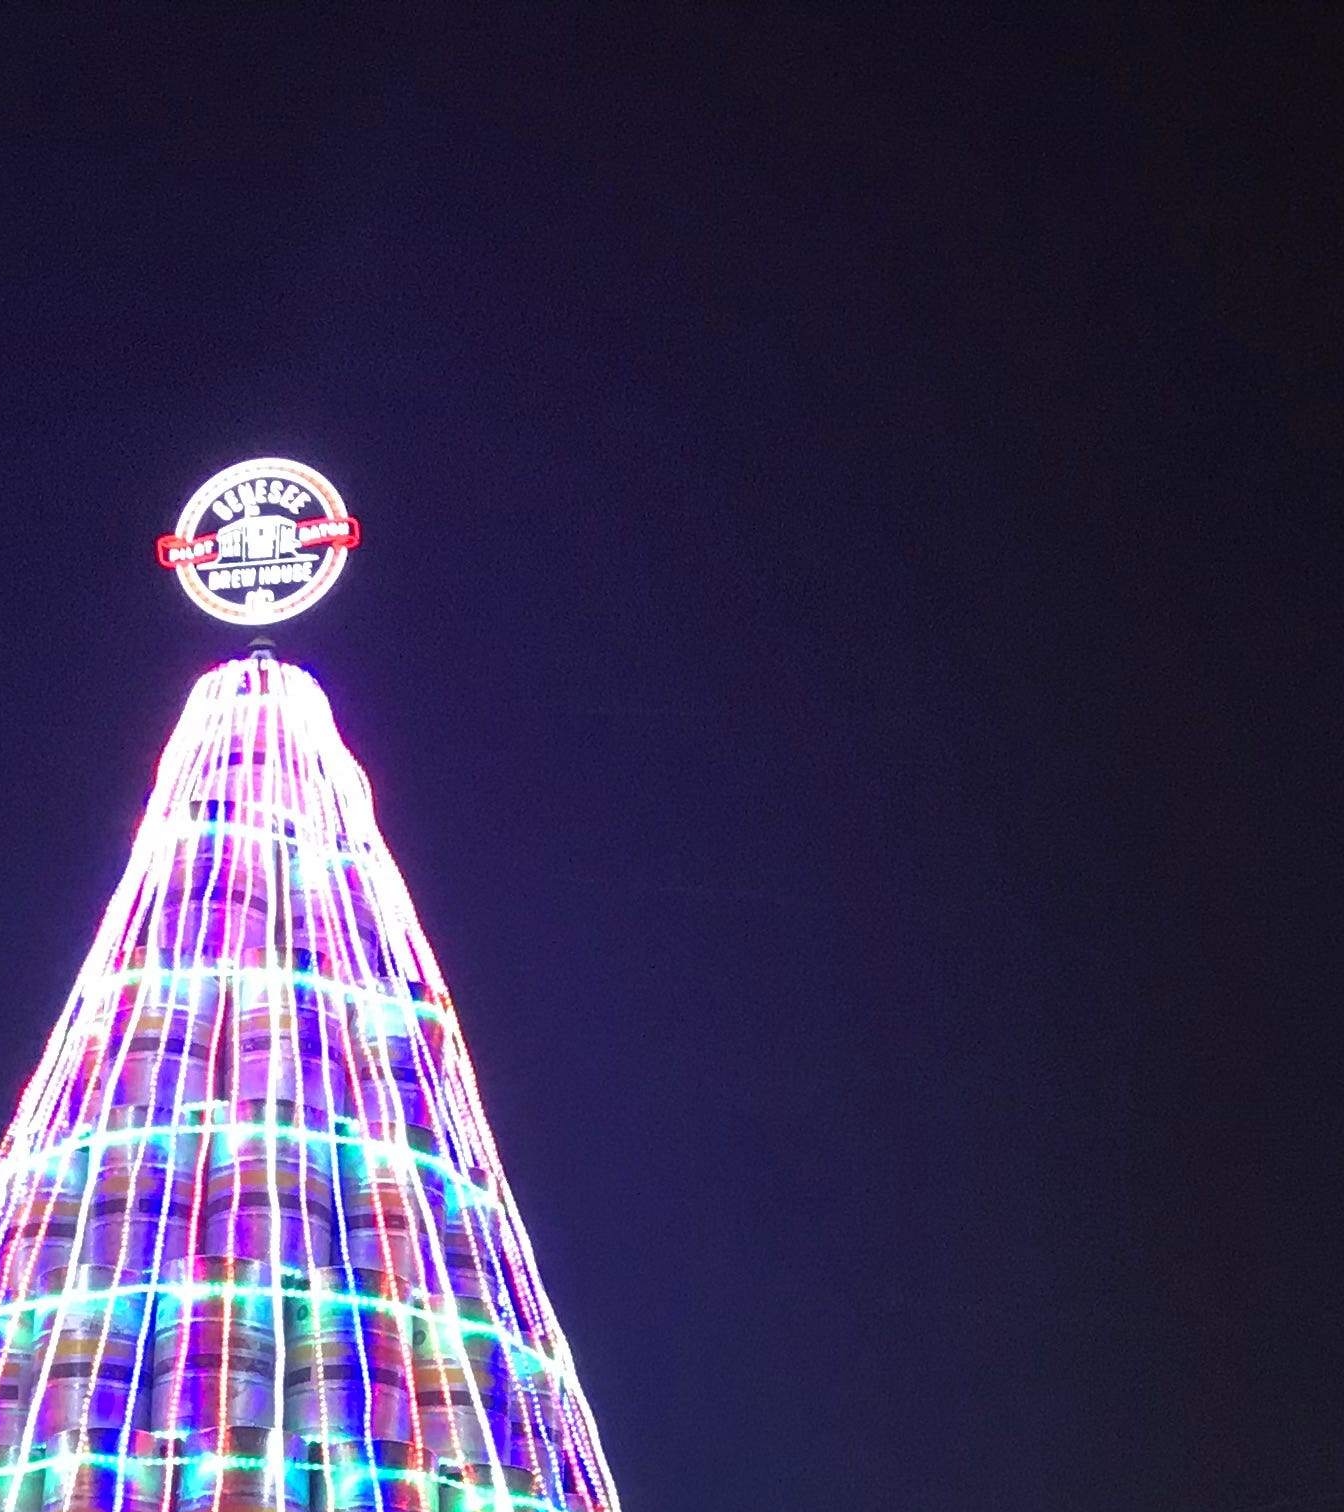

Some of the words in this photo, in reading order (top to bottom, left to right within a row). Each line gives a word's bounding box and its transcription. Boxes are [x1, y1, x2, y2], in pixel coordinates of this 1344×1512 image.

[212, 479, 312, 521] GENESEE
[208, 567, 256, 591] BREW
[258, 561, 313, 585] HOUSE
